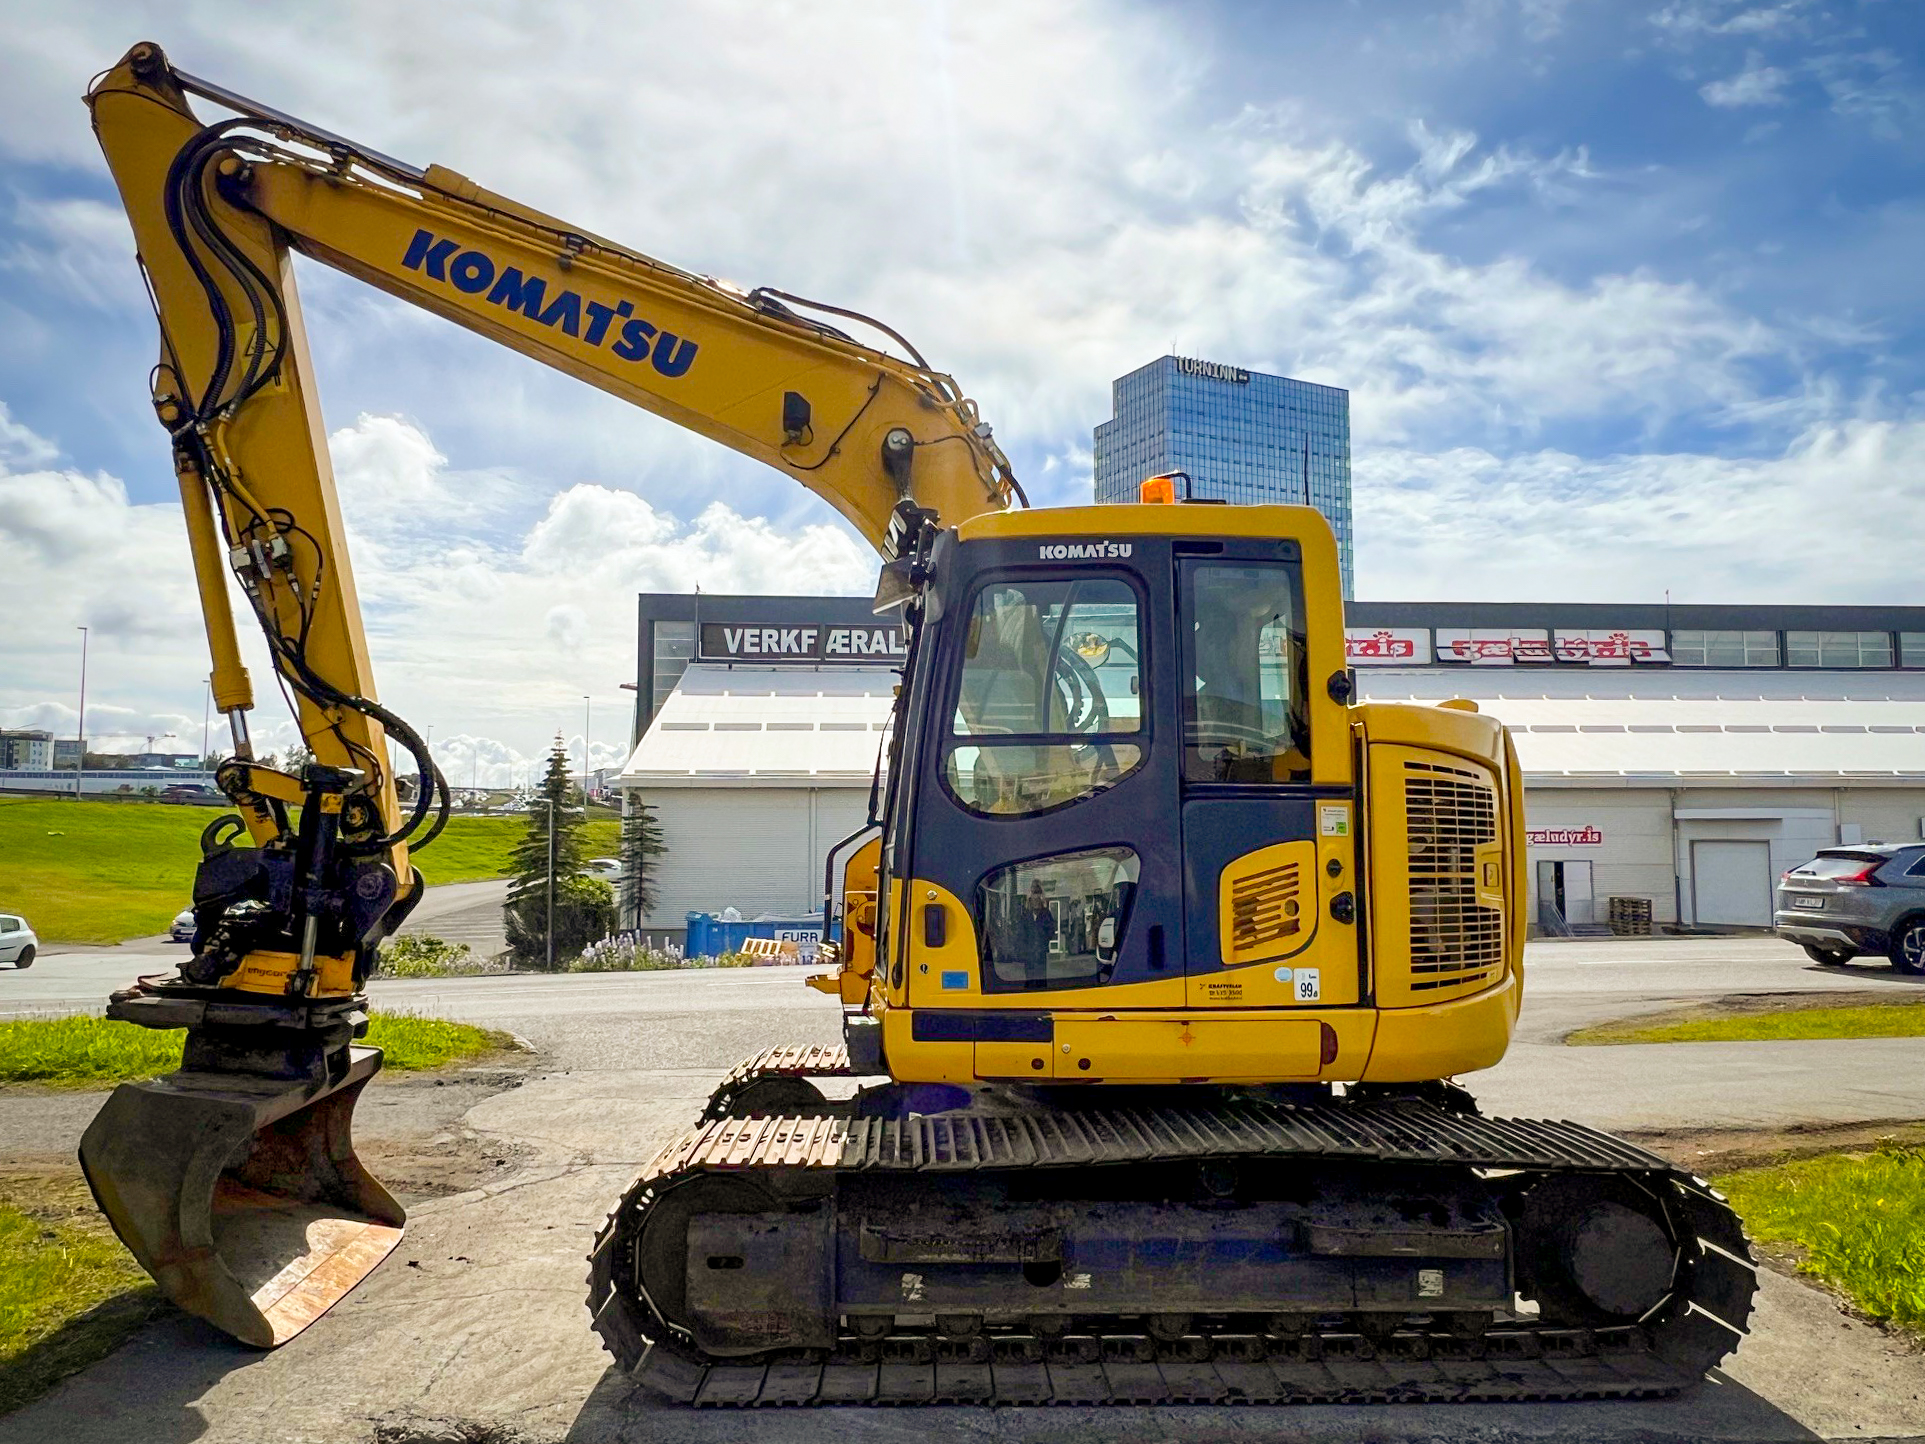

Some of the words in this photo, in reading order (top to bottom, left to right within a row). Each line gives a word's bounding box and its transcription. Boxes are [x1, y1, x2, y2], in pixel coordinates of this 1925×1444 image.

[401, 228, 699, 378] KOMATSU
[1040, 541, 1132, 559] KOMATSU
[826, 629, 906, 654] ÆRAL
[1345, 636, 1407, 656] r.is
[1300, 982, 1313, 998] 99
